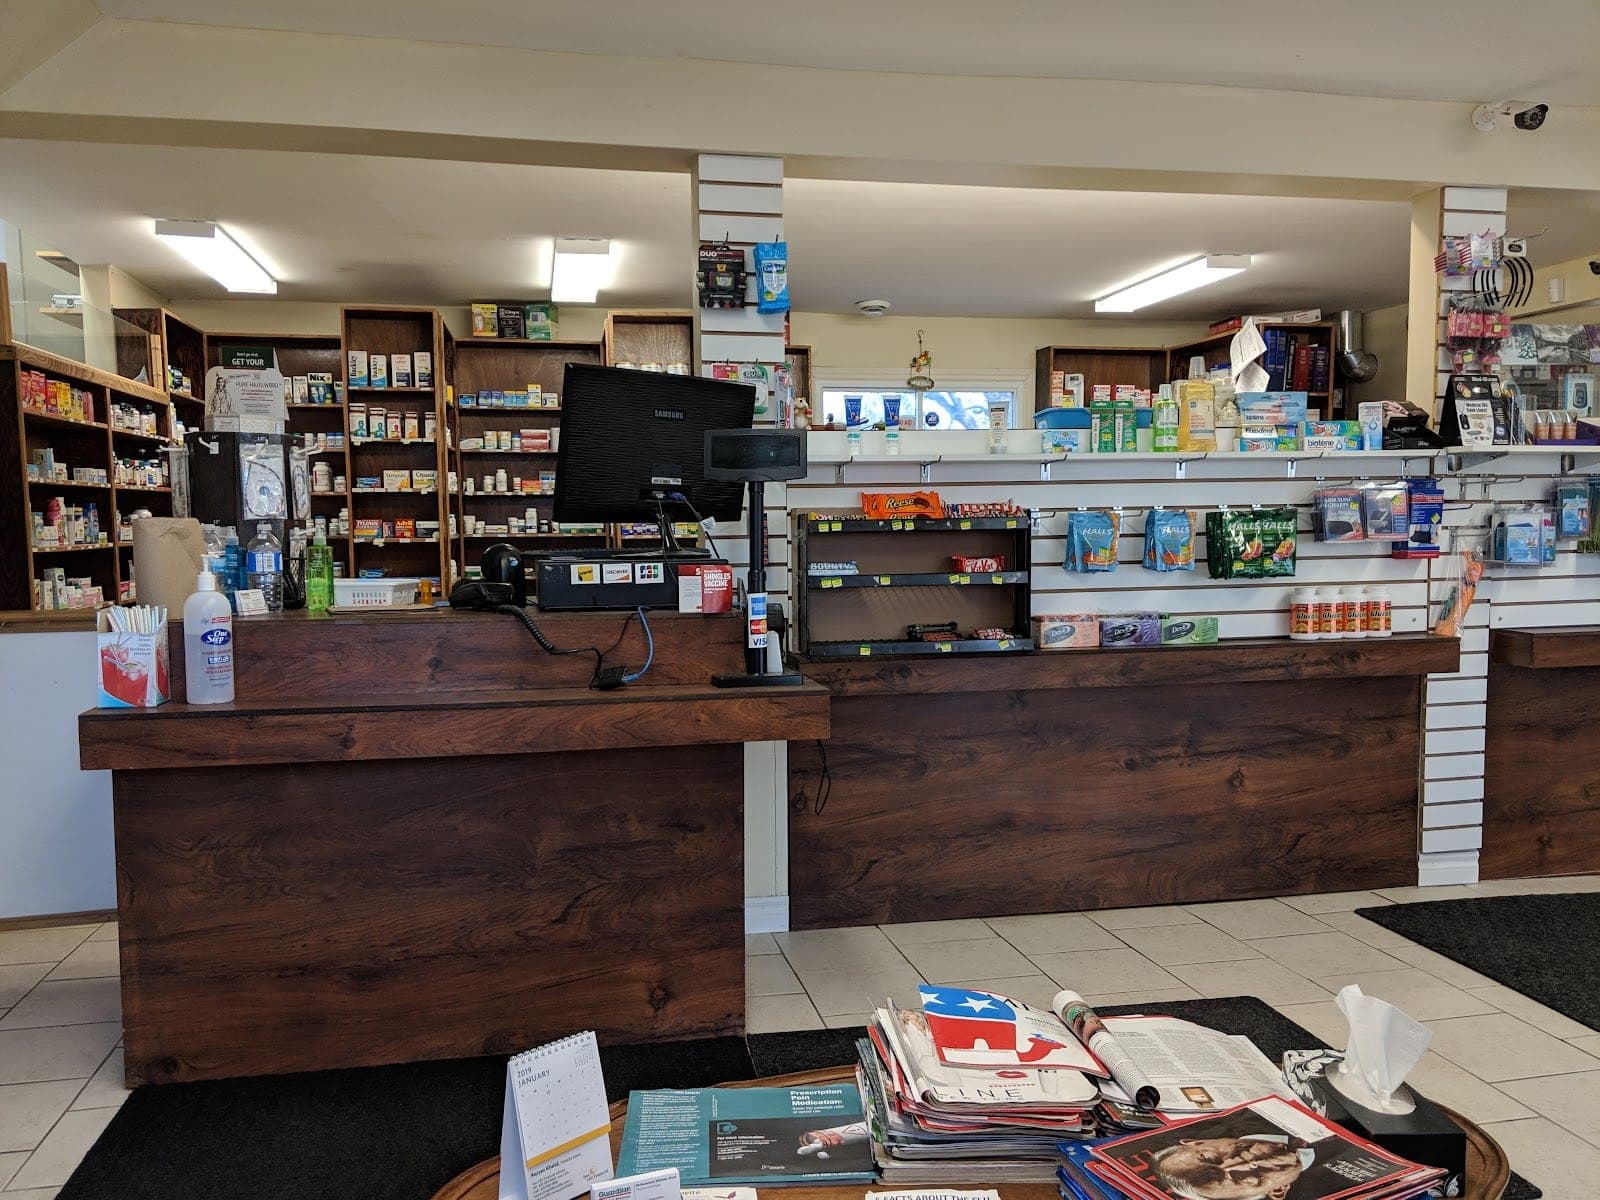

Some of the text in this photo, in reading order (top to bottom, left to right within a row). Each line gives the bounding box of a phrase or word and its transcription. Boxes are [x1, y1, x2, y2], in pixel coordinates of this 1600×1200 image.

[232, 358, 264, 366] GET YOUR
[309, 373, 325, 382] Nix
[654, 409, 684, 419] SAMSUNG
[1228, 520, 1262, 531] HALLS
[1262, 520, 1295, 530] HALLS
[1082, 527, 1114, 536] HALLS
[1160, 526, 1191, 535] HALLS
[206, 633, 225, 645] Step
[213, 630, 228, 638] One
[753, 638, 768, 646] VIS
[517, 1066, 532, 1078] 2019
[518, 1069, 550, 1089] JANUARY
[599, 1186, 631, 1198] Guardian
